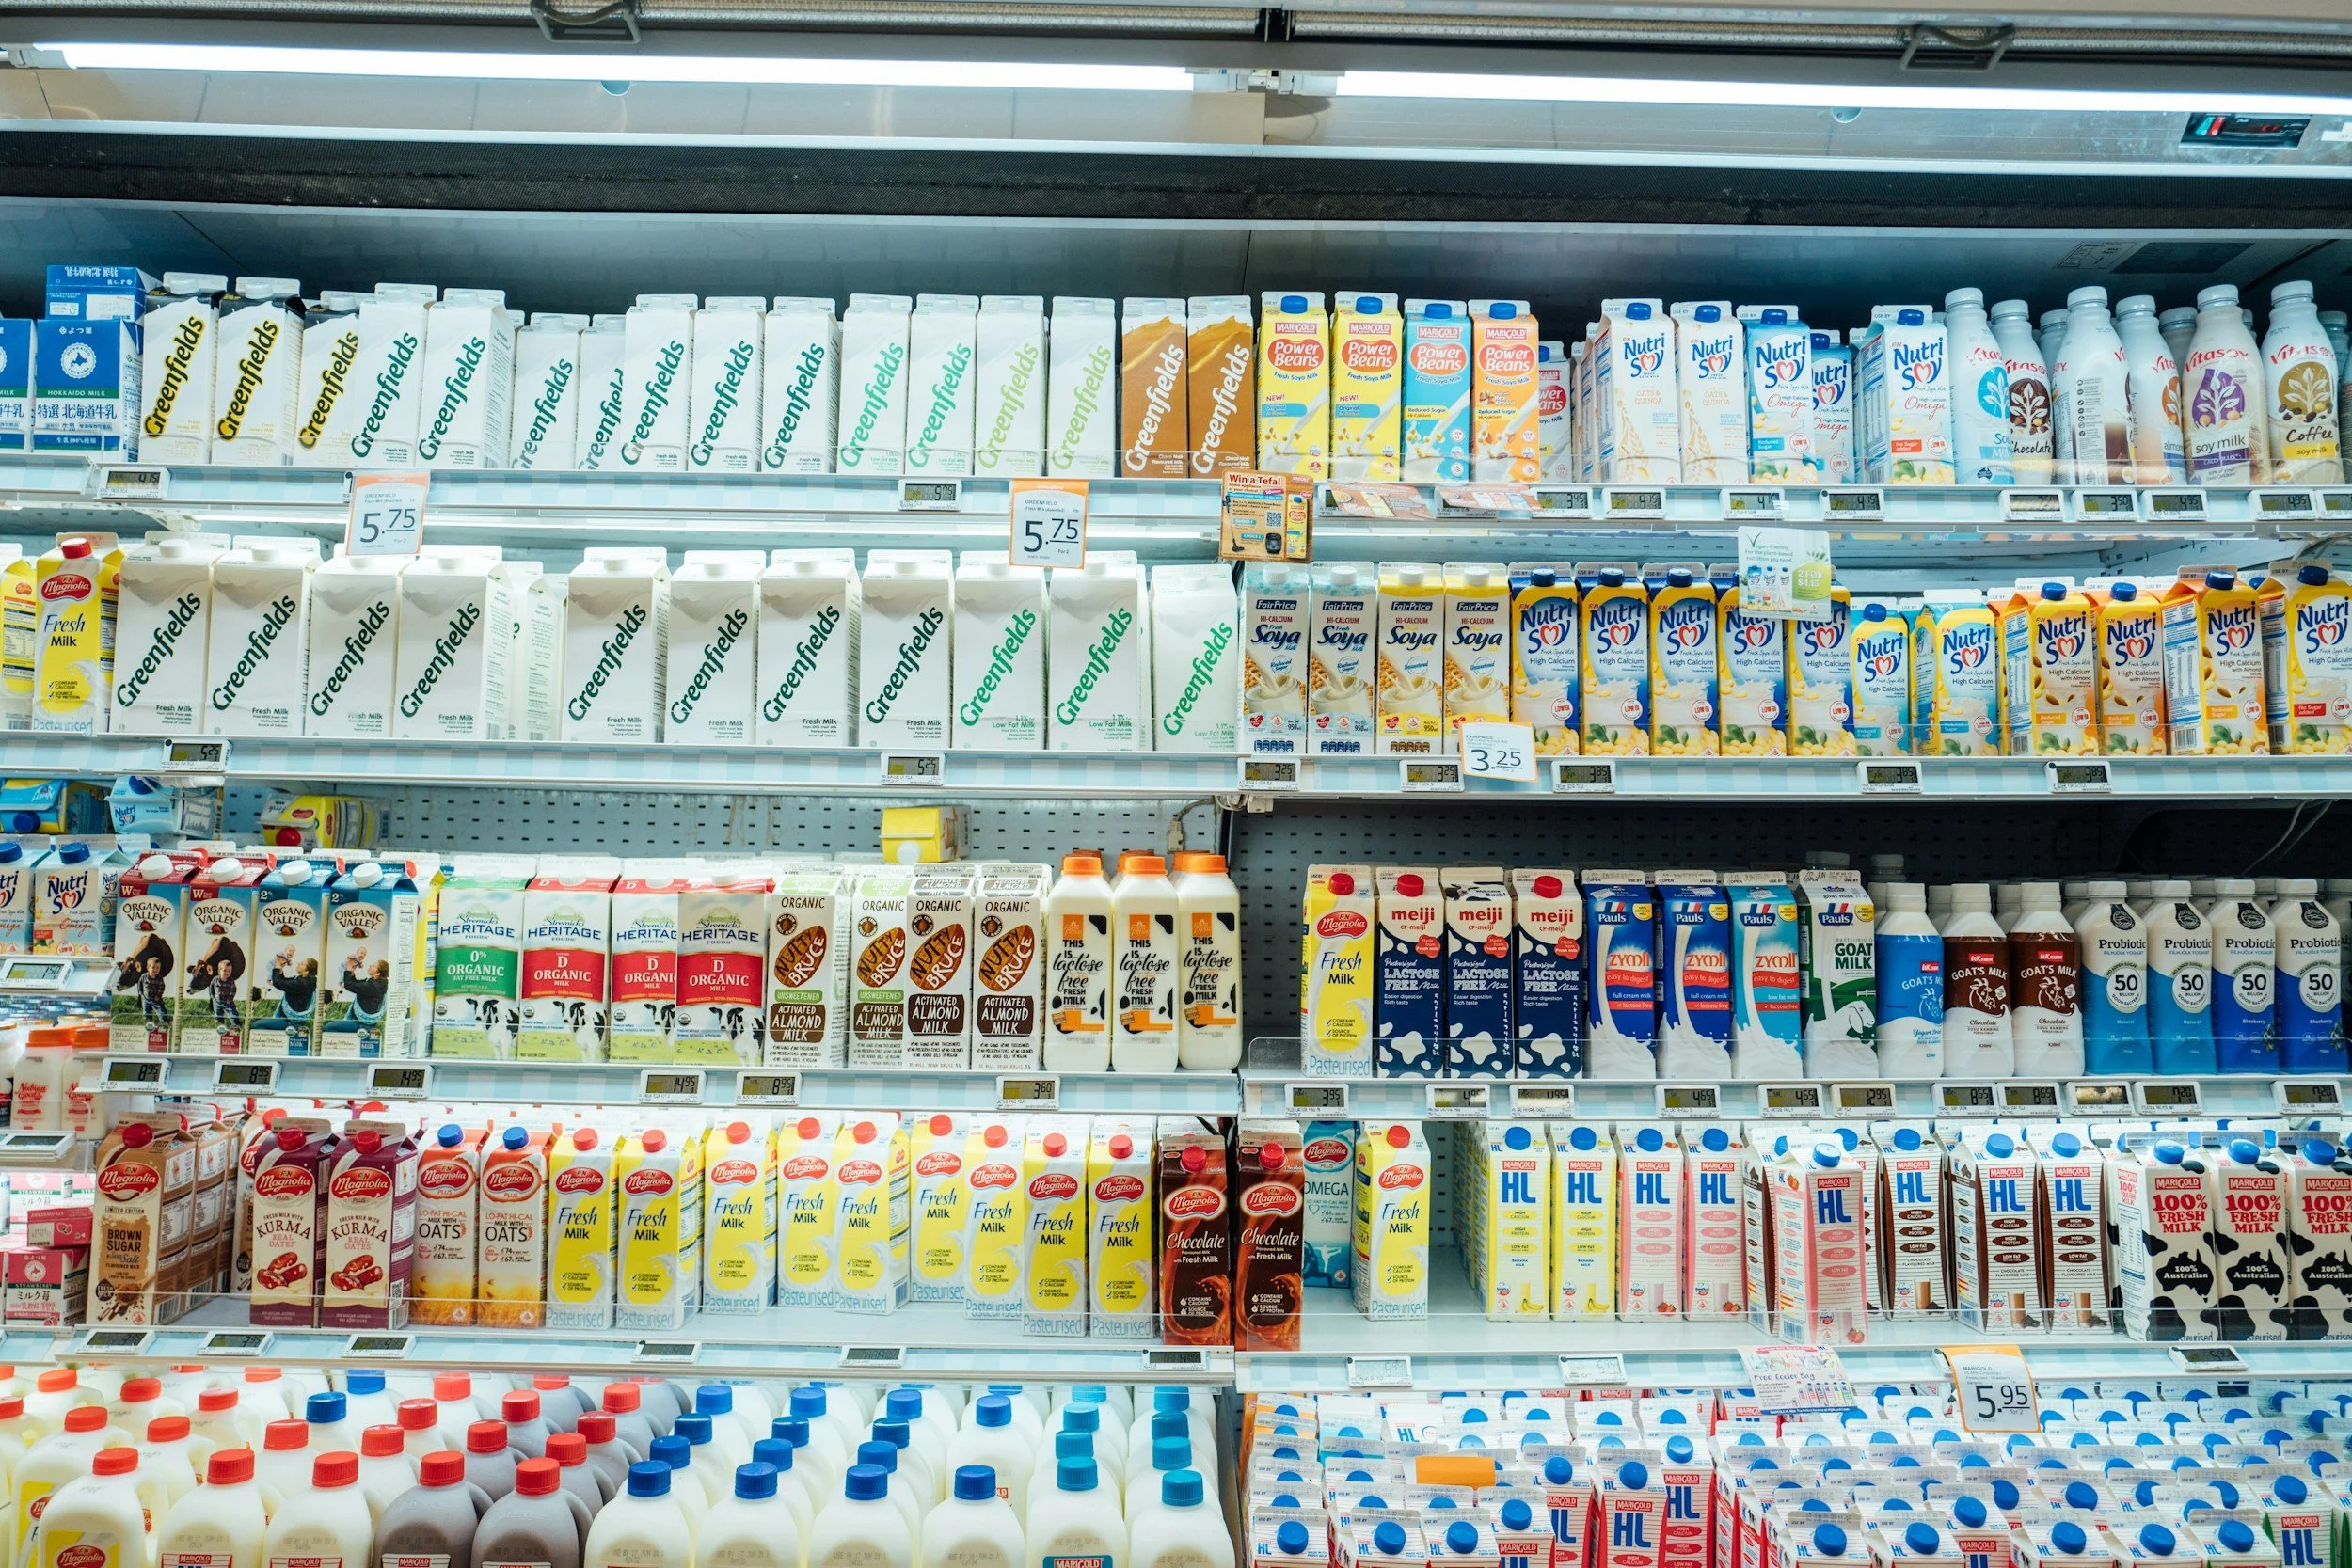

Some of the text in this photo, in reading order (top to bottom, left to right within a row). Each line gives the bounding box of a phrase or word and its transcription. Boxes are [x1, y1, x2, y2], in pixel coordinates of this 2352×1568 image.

[1276, 324, 1316, 333] MARIGOLD
[1274, 342, 1320, 355] Power
[1624, 333, 1665, 360] Nutri
[1274, 354, 1319, 367] Beans
[143, 316, 205, 438] Greenfields
[1274, 372, 1289, 380] Fresh
[689, 339, 755, 468] Greenfields
[1191, 342, 1251, 474] Greenfields
[1904, 396, 1947, 420] Omega
[38, 403, 117, 420] 特選 北海道牛乳
[2286, 425, 2333, 442] Coffee
[2195, 434, 2246, 454] soy milk
[2312, 446, 2328, 455] milk
[1229, 474, 1248, 483] Win
[1257, 476, 1280, 485] Tefal
[359, 508, 416, 543] 5.75
[1024, 518, 1079, 553] 5.75
[1804, 570, 1824, 579] FOR
[46, 581, 90, 596] Magnolia
[1797, 578, 1820, 588] $4.15
[1257, 600, 1295, 610] FairPrice
[1520, 597, 1572, 632] Nutri
[44, 612, 85, 633] Fresh
[51, 636, 77, 647] Milk
[1250, 625, 1301, 650] Soya
[211, 594, 297, 713] Greenfields
[960, 606, 1037, 728] Greenfields
[1554, 705, 1565, 714] LOW
[1470, 749, 1523, 772] 3.25
[122, 902, 172, 916] ORGANIC
[334, 909, 385, 923] ORGANIC
[1391, 908, 1435, 924] meiji
[126, 911, 166, 925] VALLEY
[1598, 912, 1627, 924] Pauls
[440, 925, 515, 939] HERITAGE
[1062, 940, 1084, 948] THIS
[1835, 943, 1873, 957] GOAT
[469, 951, 487, 962] 0%
[774, 928, 813, 979] NUTTY
[1064, 950, 1073, 958] IS
[557, 956, 568, 969] D
[788, 937, 825, 988] BRUCE
[1053, 953, 1104, 972] lactose
[1835, 956, 1872, 969] MILK
[447, 964, 504, 977] ORGANIC
[534, 970, 592, 983] ORGANIC
[1385, 969, 1440, 980] LACTOSE
[1951, 967, 2008, 981] GOAT'S MILK
[1058, 970, 1089, 992] free
[1386, 980, 1418, 990] FREE
[1629, 975, 1649, 984] digest
[2115, 974, 2138, 990] 50
[777, 991, 820, 1000] UNSWEETENED
[915, 996, 957, 1006] ACTIVATED
[1063, 996, 1086, 1005] MILK
[913, 1006, 960, 1021] ALMOND
[923, 1021, 948, 1034] MILK
[1310, 1055, 1371, 1076] Pasteurised
[1503, 1162, 1535, 1170] MARIGOLD
[102, 1172, 156, 1188] Magnolia
[258, 1177, 311, 1193] Magnolia
[1033, 1180, 1076, 1193] Magnolia
[2156, 1178, 2200, 1189] MARIGOLD
[1502, 1172, 1536, 1204] HL
[1989, 1180, 2026, 1212] HL
[2152, 1194, 2208, 1211] 100%
[2157, 1211, 2205, 1222] FRESH
[107, 1229, 142, 1241] BROWN
[256, 1221, 310, 1240] KURMA
[419, 1224, 461, 1239] OATS
[634, 1229, 660, 1241] Milk
[2162, 1223, 2202, 1233] MILK
[1241, 1228, 1299, 1247] Chocolate
[107, 1241, 141, 1252] SUGAR
[18, 1291, 50, 1301] ミルク苺
[1976, 1385, 2030, 1418] 5.95
[1616, 1500, 1652, 1512] MARIGOLD
[1613, 1513, 1652, 1548] HL
